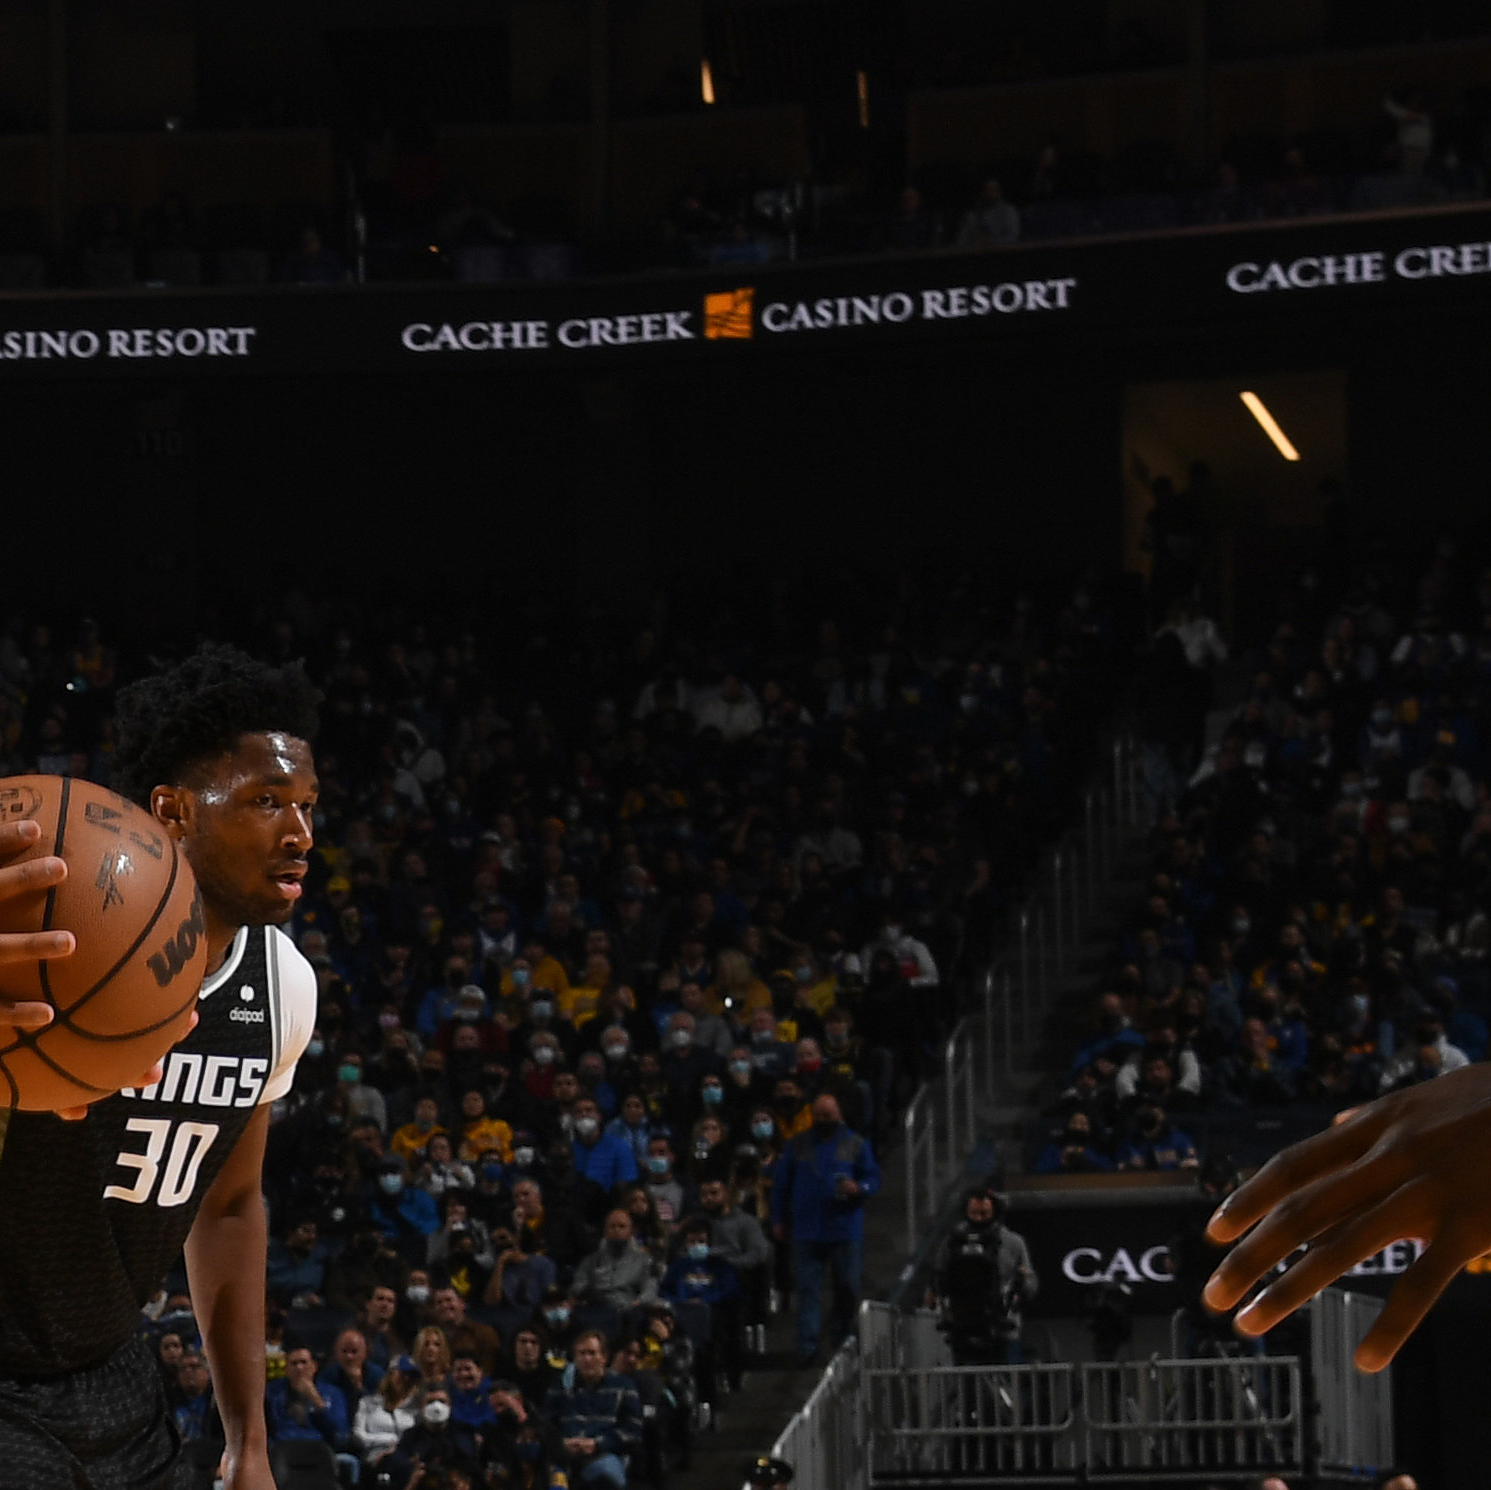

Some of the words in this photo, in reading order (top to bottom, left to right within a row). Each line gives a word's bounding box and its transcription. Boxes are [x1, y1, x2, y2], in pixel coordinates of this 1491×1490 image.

[1227, 251, 1386, 294] CACHE
[1395, 241, 1491, 279] CRE
[761, 289, 915, 334] CASINO
[922, 275, 1078, 320] RESORT
[108, 326, 258, 358] RESORT
[401, 317, 550, 353] CACHE
[557, 311, 695, 349] CREEK
[229, 1006, 265, 1025] dialpad
[120, 1052, 269, 1108] NGS
[102, 1117, 220, 1208] 30
[1062, 1245, 1175, 1285] CAC
